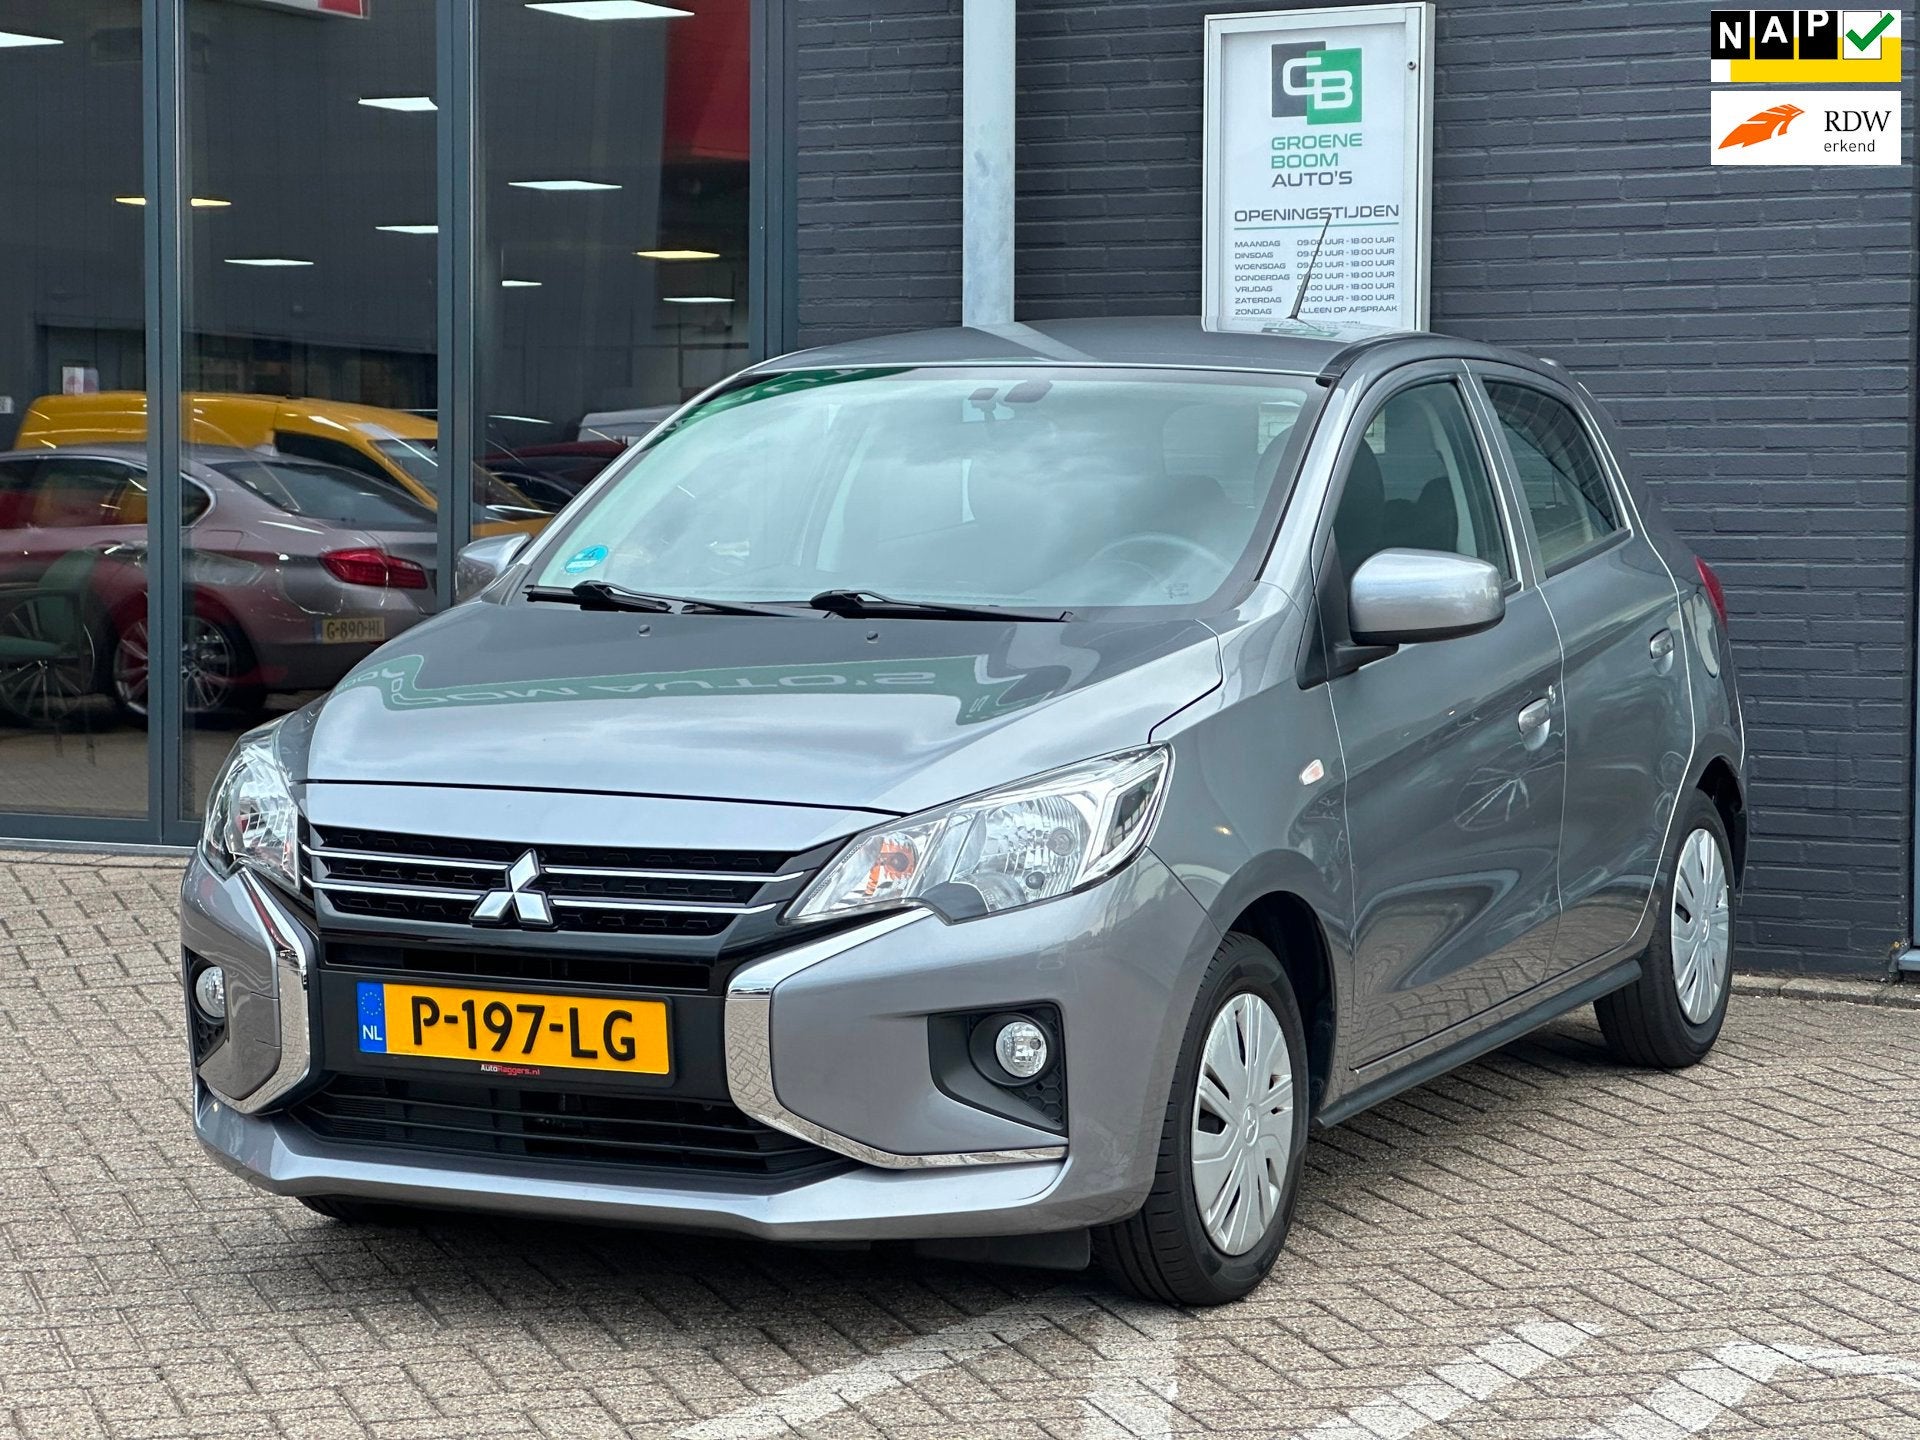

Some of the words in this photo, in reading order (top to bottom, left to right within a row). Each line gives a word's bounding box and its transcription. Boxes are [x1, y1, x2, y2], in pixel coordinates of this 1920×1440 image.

[1271, 133, 1363, 150] GROENE
[1271, 153, 1338, 169] BOOM
[1271, 171, 1353, 188] AUTO'S
[1234, 204, 1399, 222] OPENINGSTIJDEN
[1234, 262, 1286, 270] WOENSDAG
[1234, 273, 1290, 281] DONDERDAG
[1234, 285, 1273, 293] VRIJDAG
[1234, 296, 1282, 304] ZATERDAG
[1234, 308, 1272, 316] ZONDAG
[1348, 305, 1398, 313] AFSPRAAK
[326, 620, 383, 640] G-890-HL
[362, 1025, 383, 1041] NL
[411, 995, 636, 1062] P-197-LG
